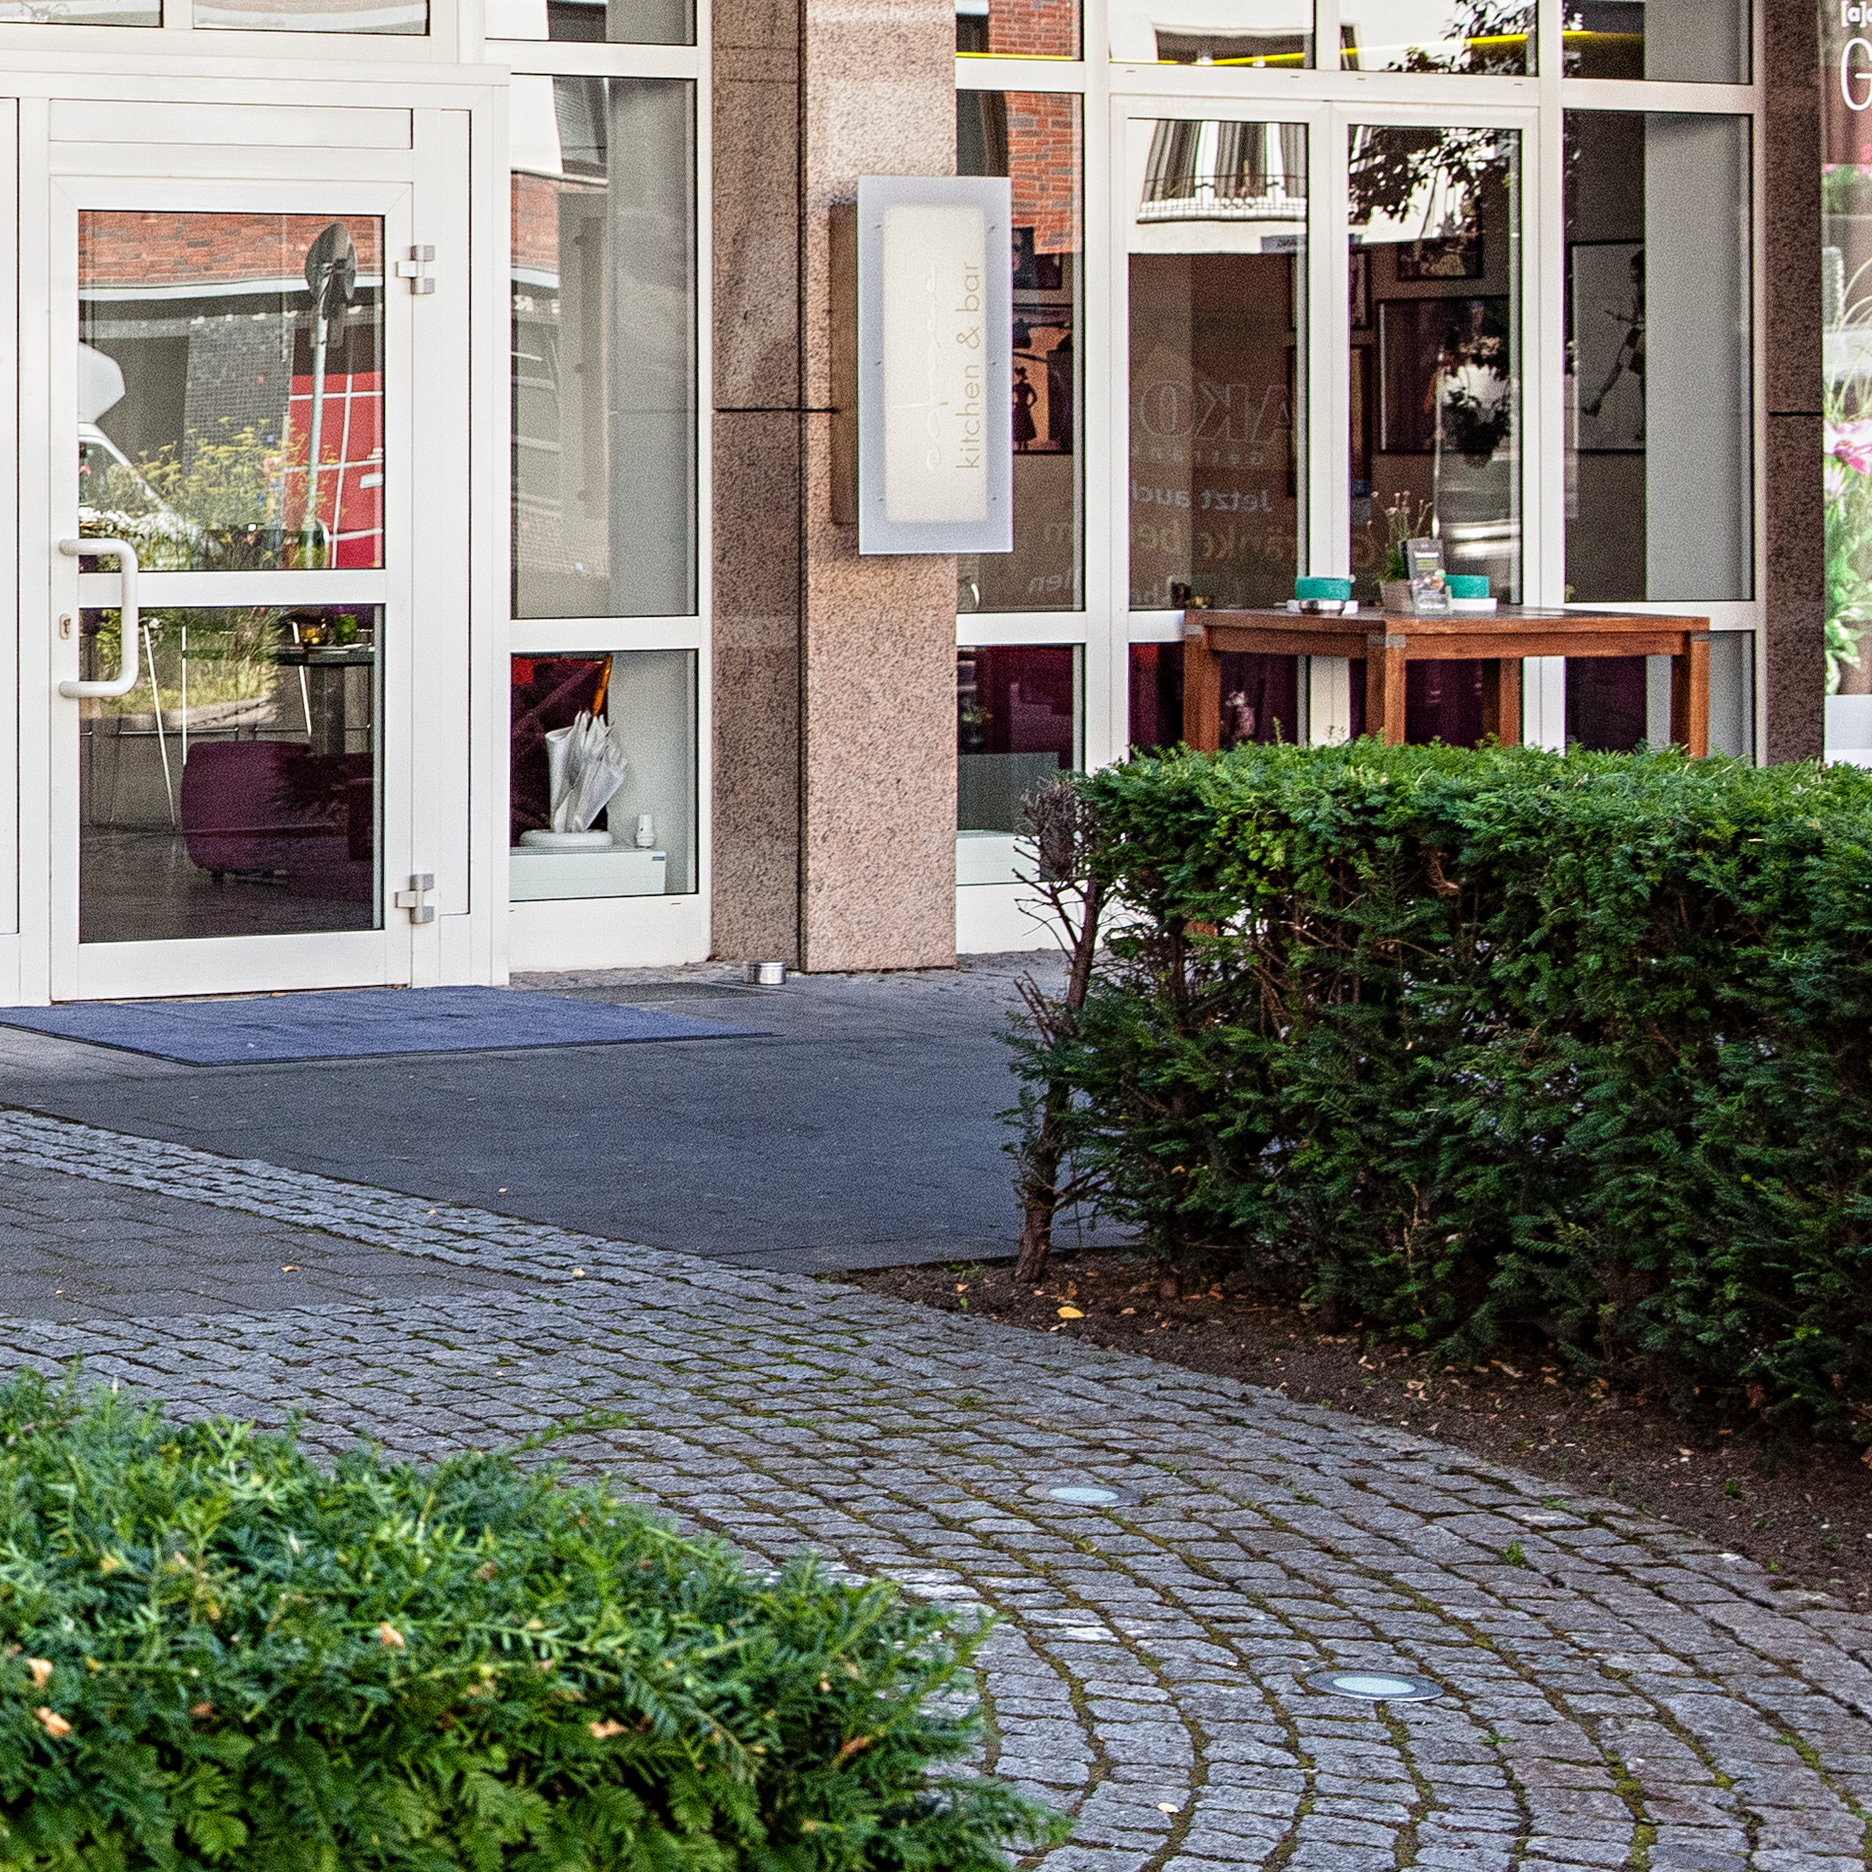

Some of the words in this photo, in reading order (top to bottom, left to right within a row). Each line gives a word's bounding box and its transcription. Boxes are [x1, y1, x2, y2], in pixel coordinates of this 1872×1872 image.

[955, 261, 983, 313] bar
[956, 327, 982, 348] &
[955, 363, 982, 470] kitchen
